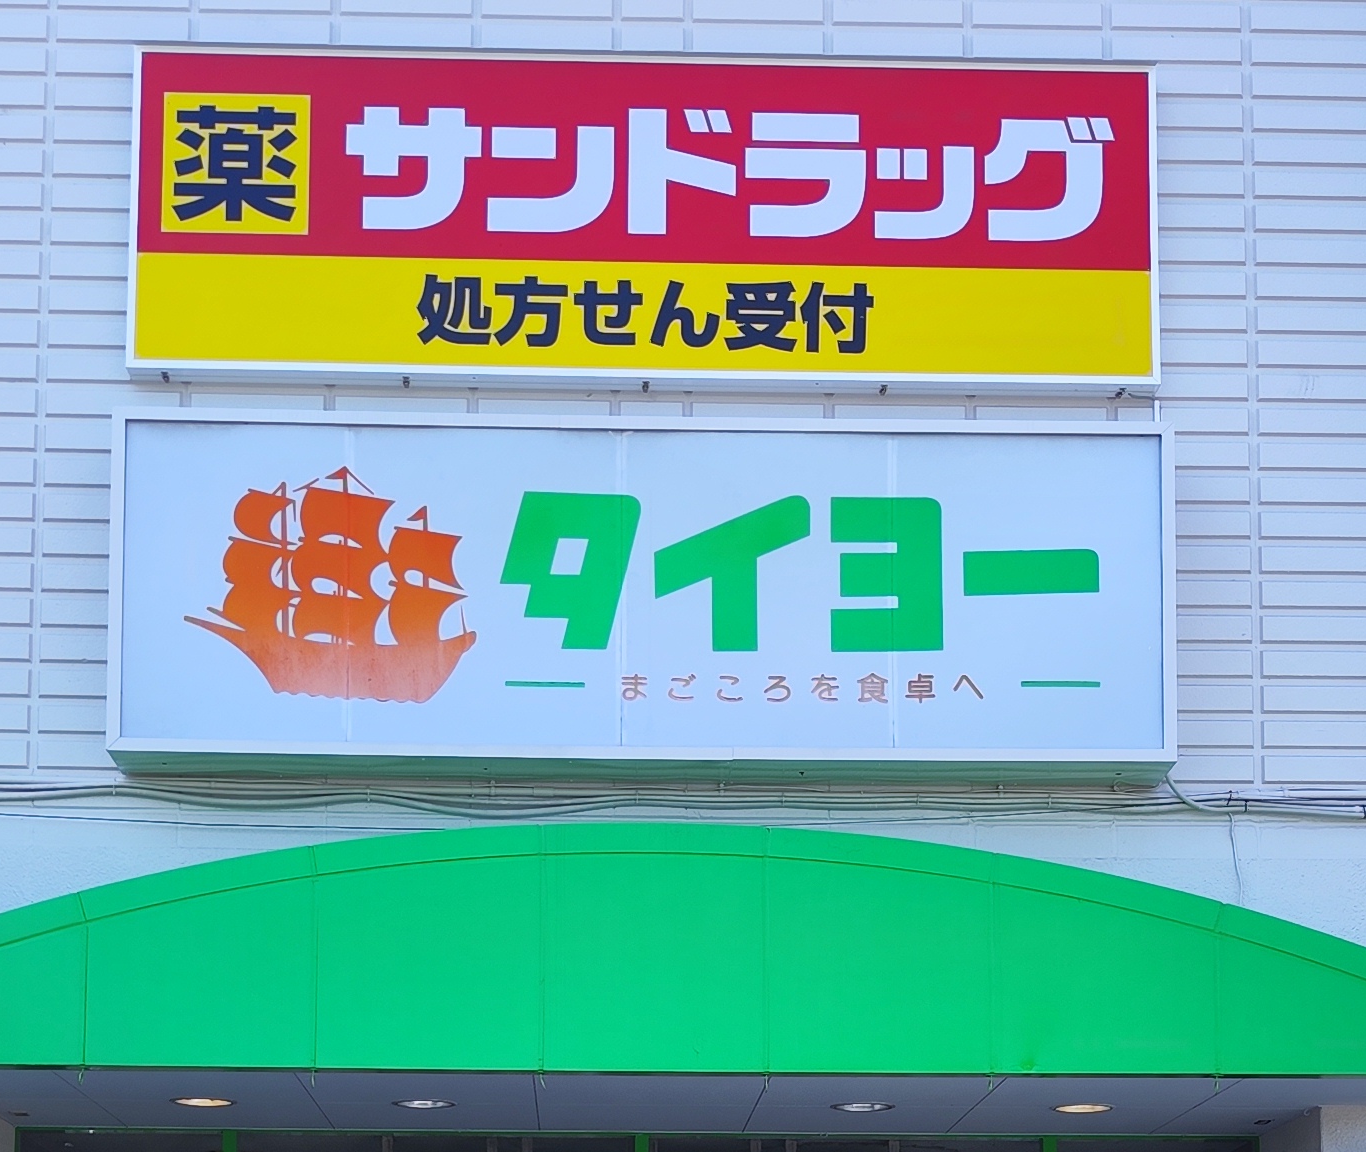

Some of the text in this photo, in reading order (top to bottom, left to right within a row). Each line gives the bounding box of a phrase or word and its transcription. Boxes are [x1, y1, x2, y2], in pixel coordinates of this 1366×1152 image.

[173, 104, 1116, 242] 薬 サンドラッグ
[416, 273, 875, 354] 処方せん受付
[499, 490, 1100, 652] タイヨー
[621, 672, 985, 704] まごころを食卓へ
